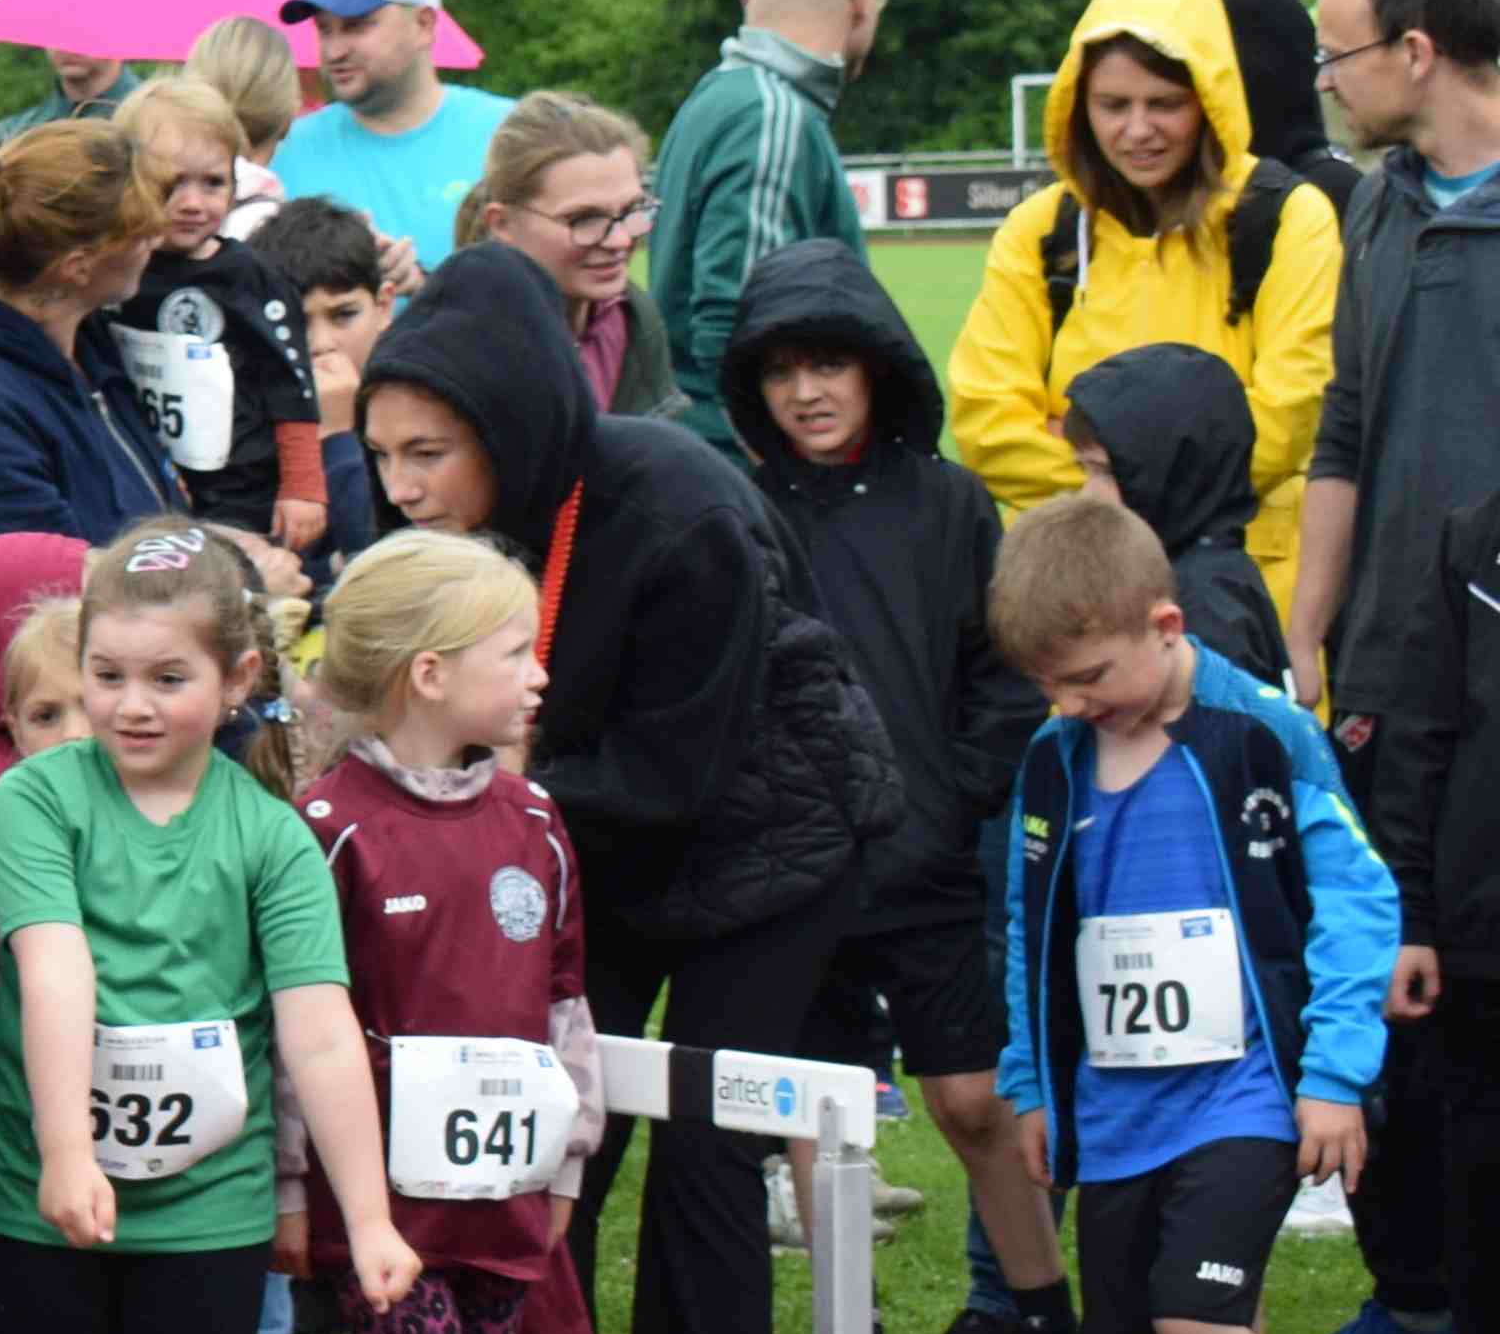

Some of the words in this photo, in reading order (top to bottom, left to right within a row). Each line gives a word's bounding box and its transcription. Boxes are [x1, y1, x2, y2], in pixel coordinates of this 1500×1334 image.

[142, 388, 184, 439] 65
[1097, 979, 1190, 1035] 720
[718, 1074, 770, 1106] artec
[444, 1108, 537, 1166] 641
